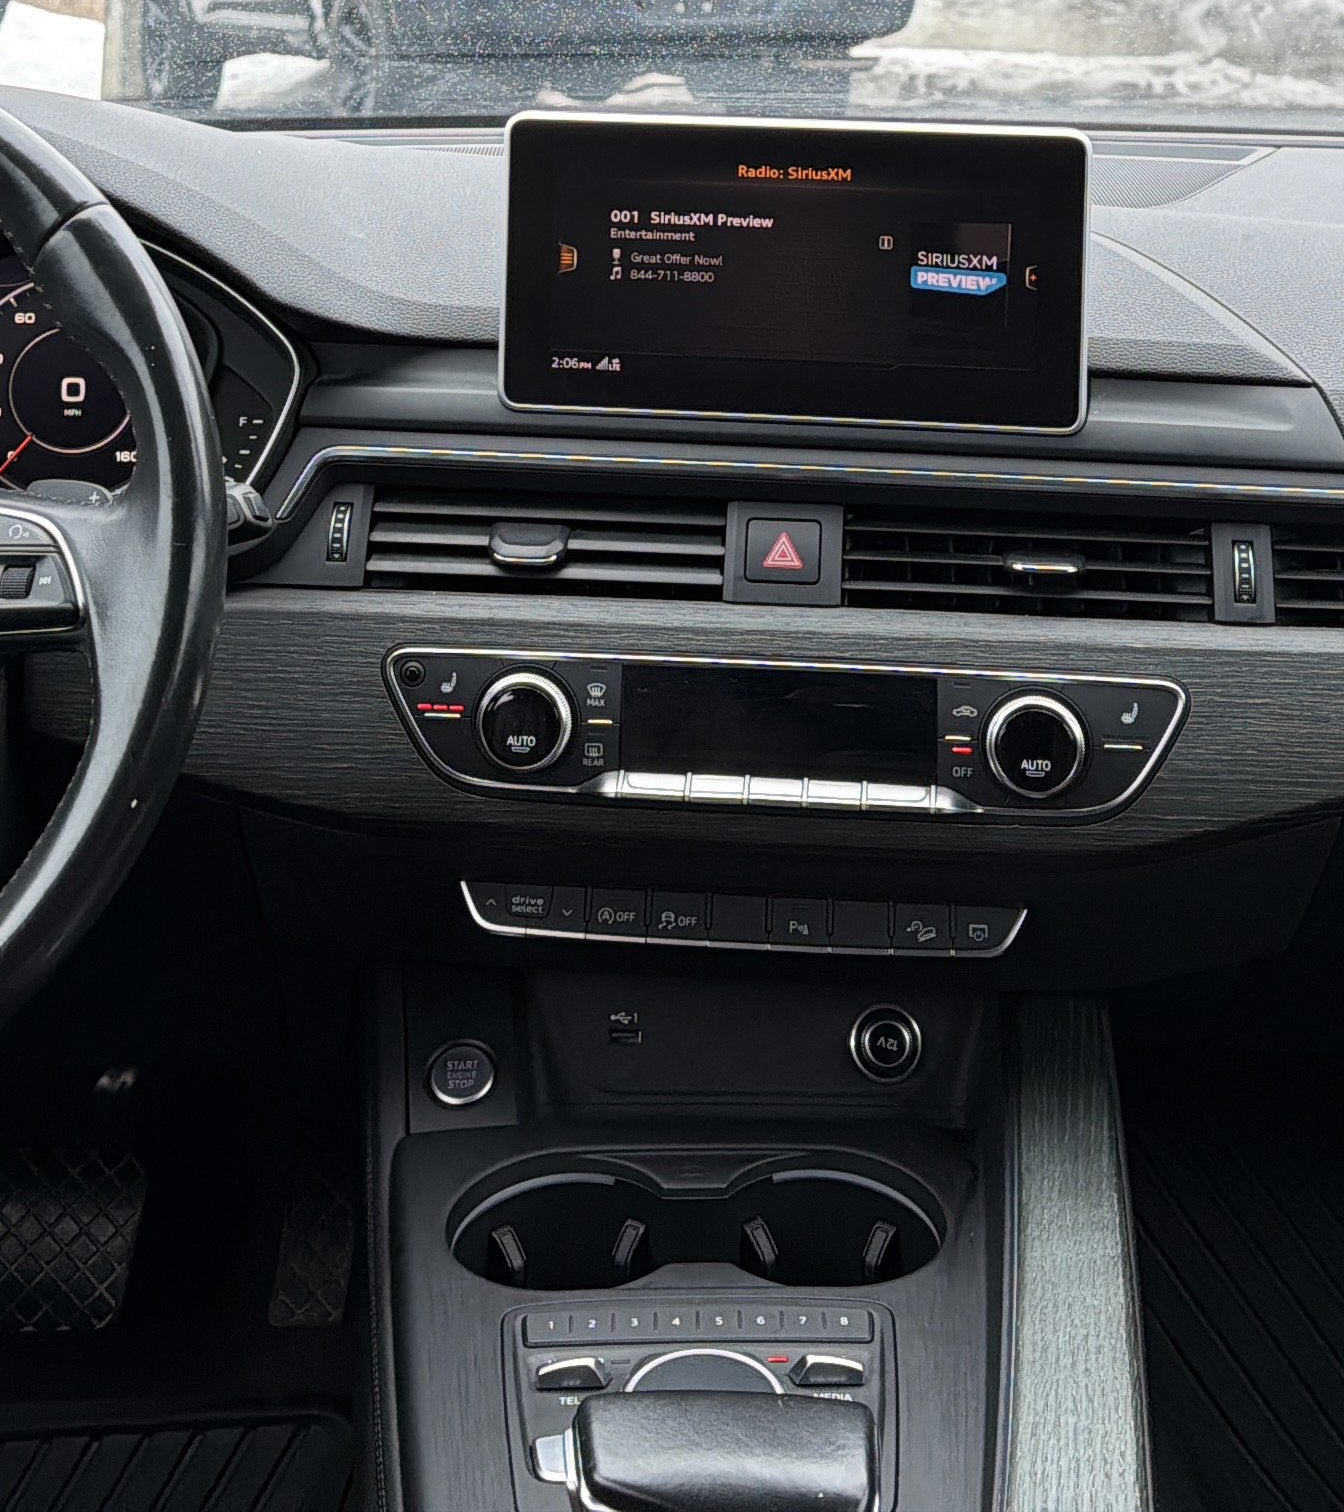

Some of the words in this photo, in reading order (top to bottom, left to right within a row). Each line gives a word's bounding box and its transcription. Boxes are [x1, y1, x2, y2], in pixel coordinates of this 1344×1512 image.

[737, 164, 784, 180] Radio:
[787, 165, 852, 182] SiriusXM
[610, 210, 639, 223] 001
[651, 211, 713, 226] SiriusXM
[717, 214, 774, 228] Preview
[610, 228, 695, 241] Entertainment
[630, 252, 661, 263] Great
[664, 253, 692, 265] Offer
[917, 250, 998, 270] SIRIUSXM
[630, 269, 714, 282] 844-711-8800
[917, 271, 998, 291] PREVIEW
[14, 312, 36, 324] 60
[60, 377, 86, 402] 0
[239, 416, 248, 427] F
[586, 698, 605, 707] MAX
[506, 735, 536, 747] AUTO
[582, 758, 604, 766] REAR
[1020, 759, 1051, 771] AUTO
[952, 767, 973, 778] OFF
[511, 895, 545, 906] drive
[511, 904, 544, 915] select
[615, 911, 636, 923] OFF
[677, 916, 698, 927] OFF
[876, 1036, 898, 1052] 12V
[446, 1059, 478, 1070] START
[447, 1079, 474, 1089] STOP
[547, 1320, 554, 1330] 1
[587, 1319, 597, 1329] 2
[630, 1318, 639, 1328] 3
[671, 1317, 680, 1327] 4
[715, 1316, 723, 1326] 5
[757, 1316, 765, 1326] 6
[799, 1316, 807, 1325] 7
[840, 1316, 849, 1326] 8
[558, 1396, 581, 1406] TEL
